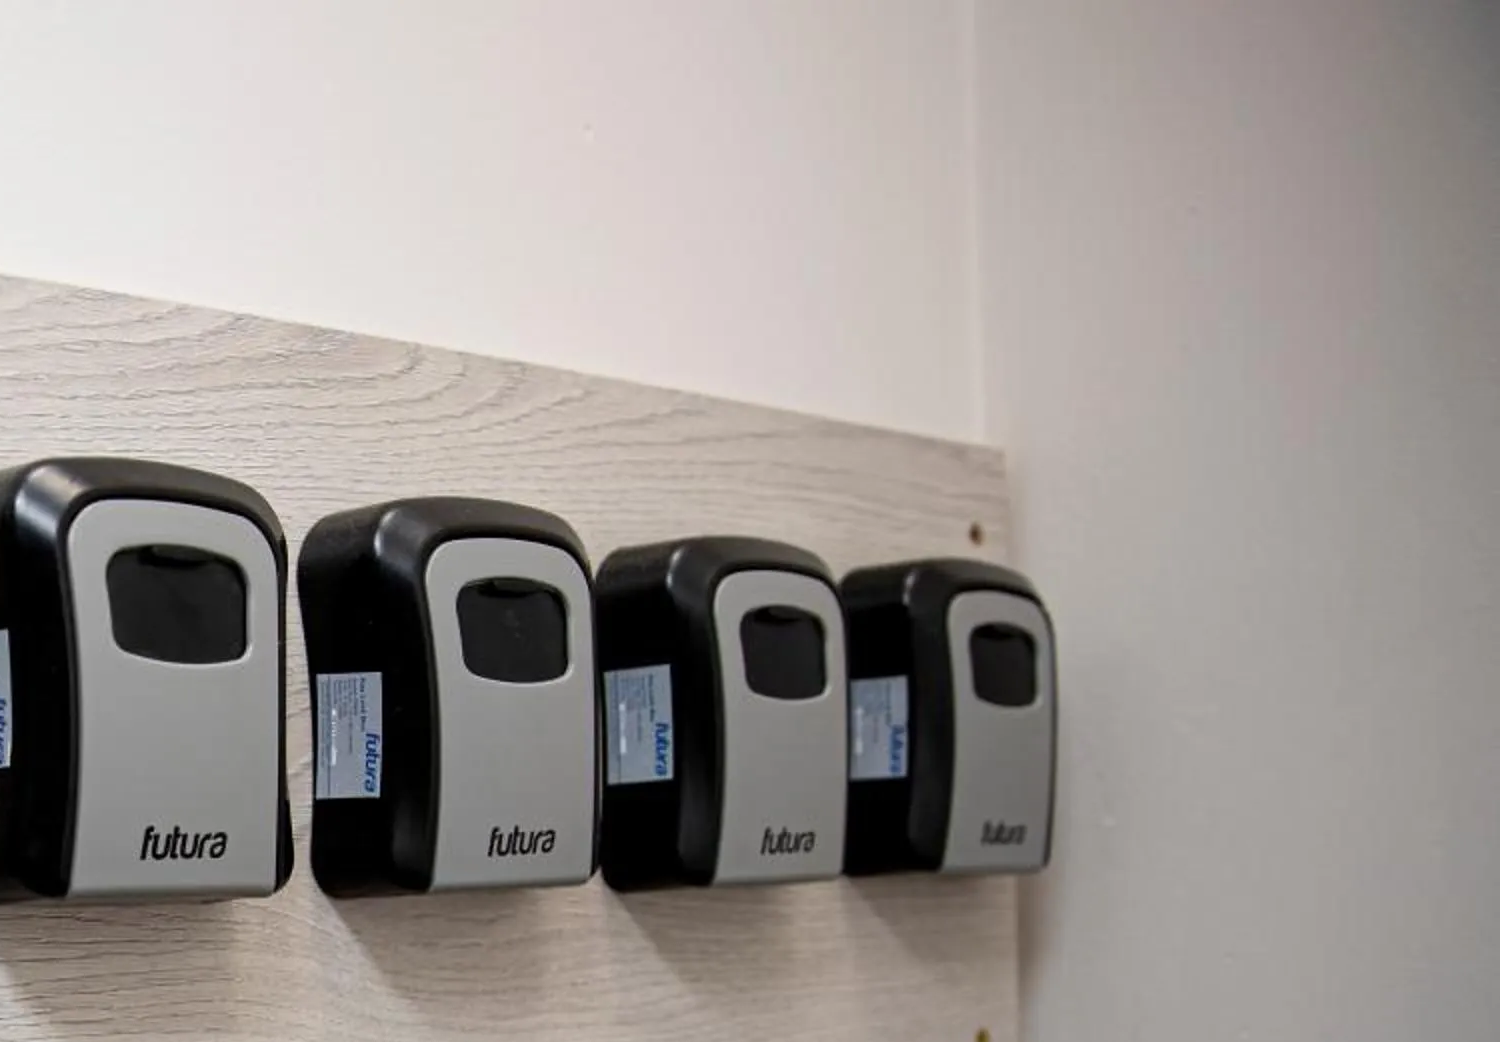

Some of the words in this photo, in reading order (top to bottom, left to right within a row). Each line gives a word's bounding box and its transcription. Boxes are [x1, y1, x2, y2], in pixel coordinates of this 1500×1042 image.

[364, 732, 380, 793] futura
[655, 723, 670, 776] futura
[139, 825, 228, 861] futura
[487, 825, 557, 858] futura
[759, 826, 817, 856] futura
[980, 821, 1027, 847] futura
